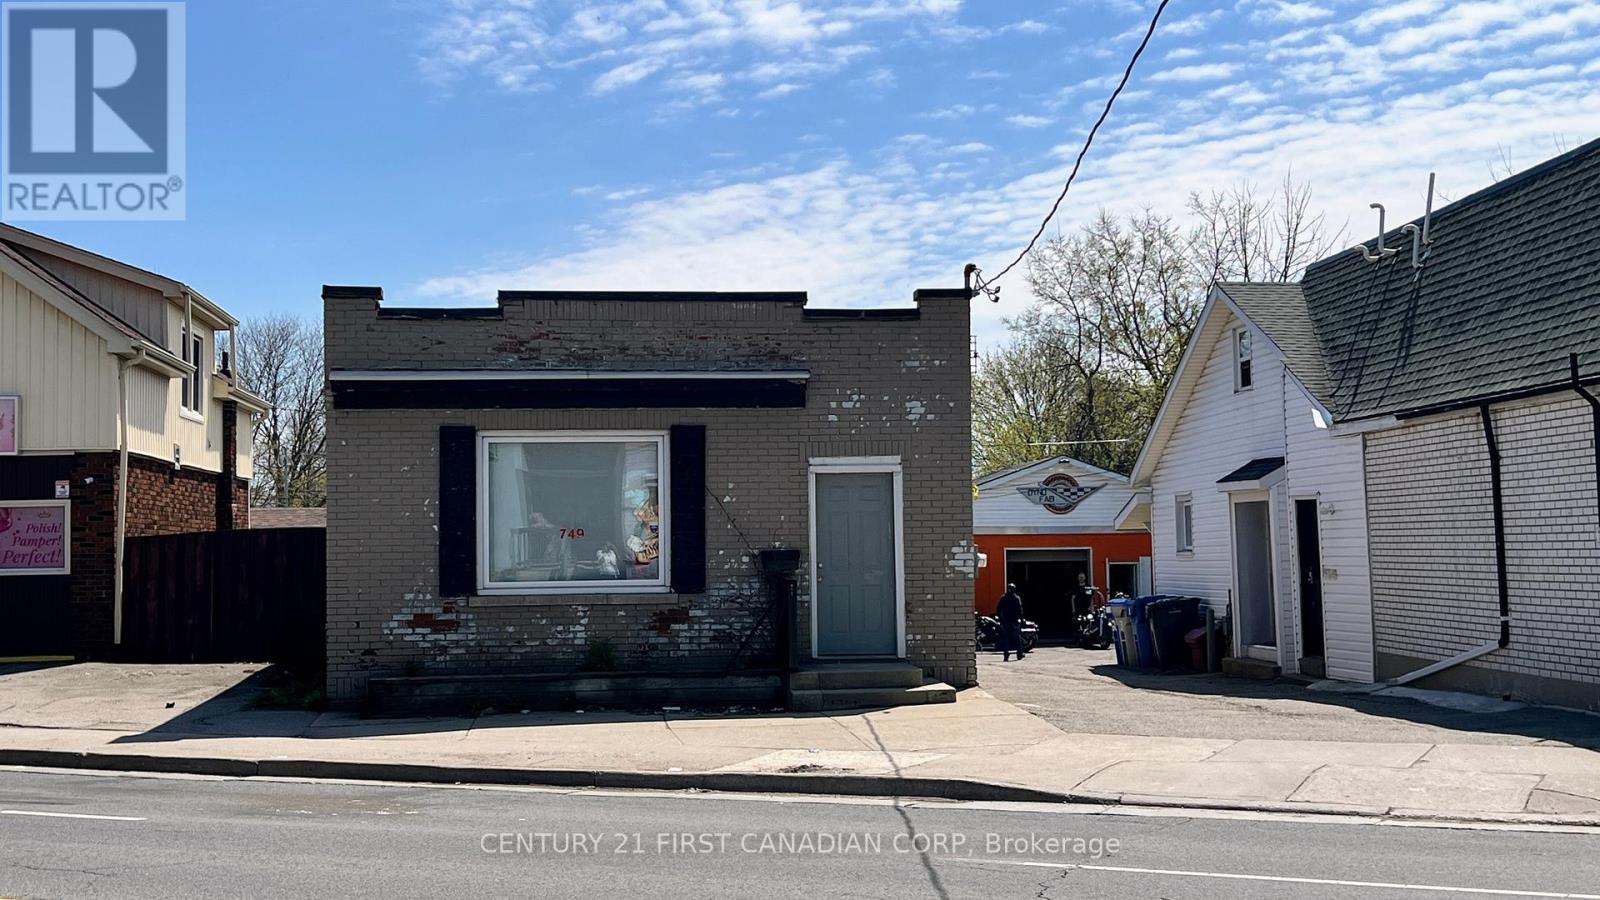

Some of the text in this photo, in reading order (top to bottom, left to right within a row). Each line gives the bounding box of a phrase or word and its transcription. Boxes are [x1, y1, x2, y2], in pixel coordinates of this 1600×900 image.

[26, 523, 62, 533] Polish!
[559, 528, 585, 539] 749
[12, 535, 62, 548] Pamper!
[2, 549, 62, 565] Perfect!
